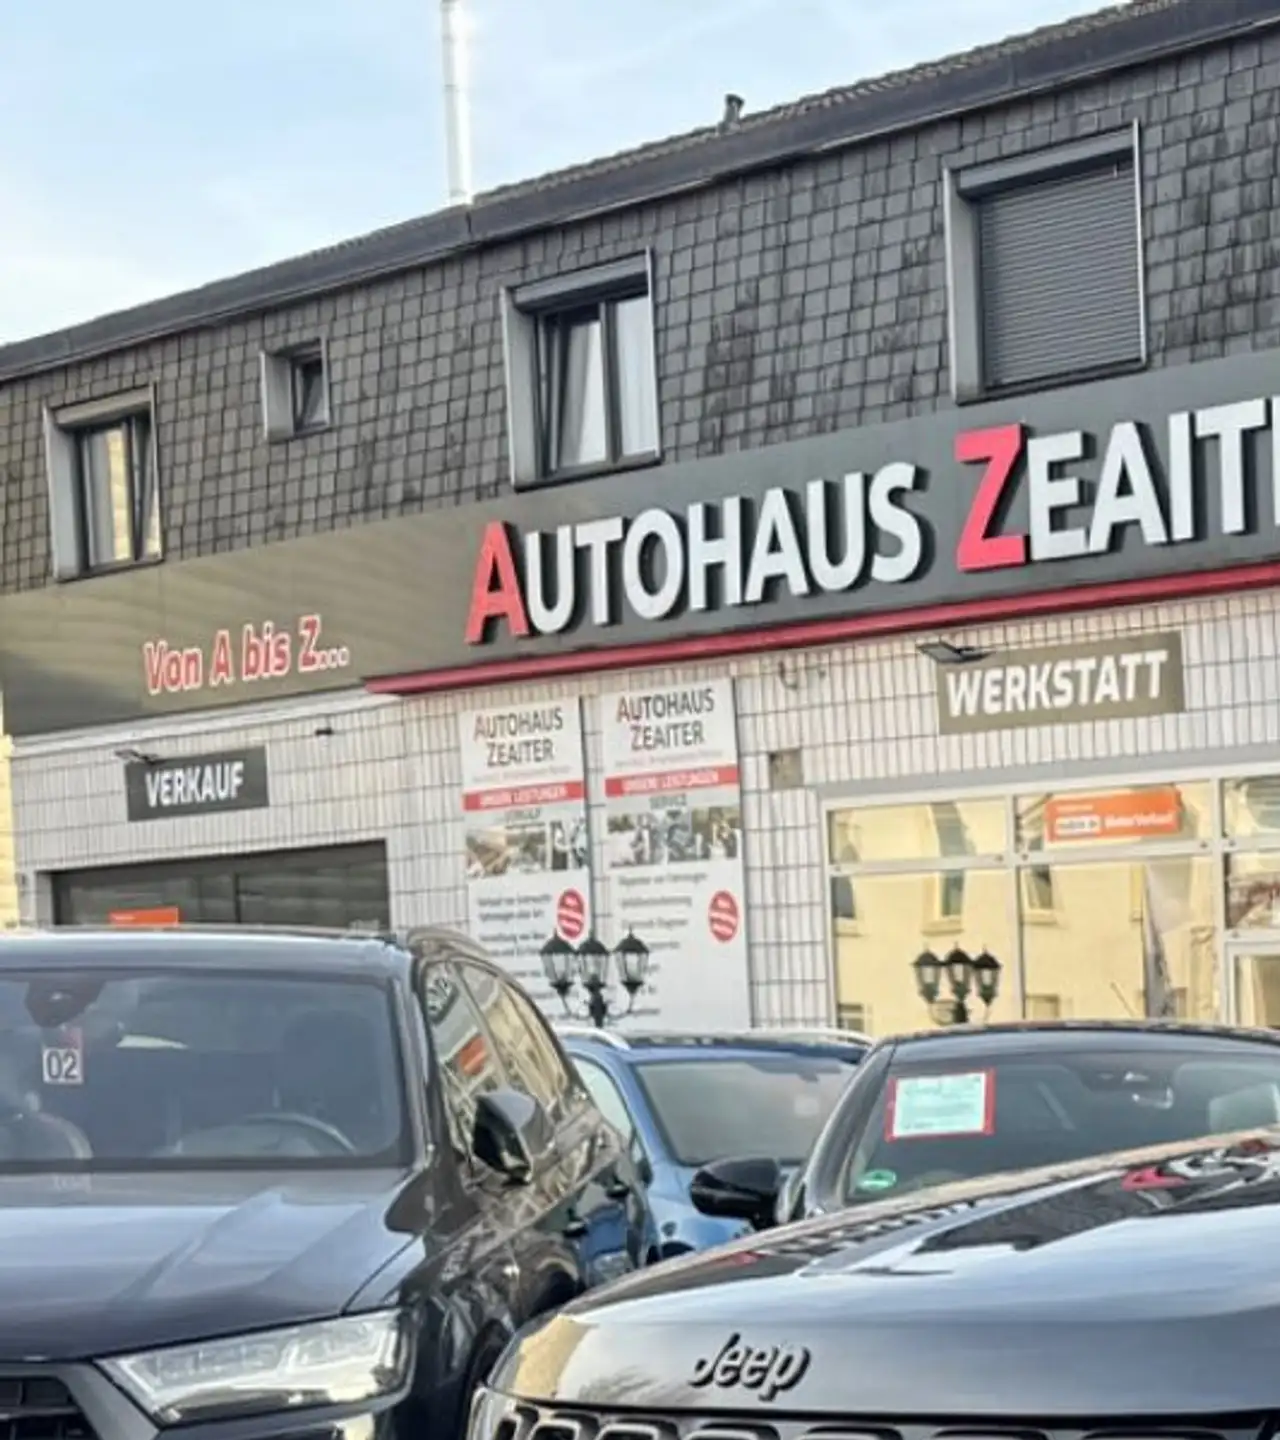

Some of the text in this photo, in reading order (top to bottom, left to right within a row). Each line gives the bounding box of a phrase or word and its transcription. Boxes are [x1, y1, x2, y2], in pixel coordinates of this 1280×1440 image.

[465, 462, 922, 645] AUTOHAUS
[144, 640, 203, 694] Von
[209, 629, 235, 686] A
[242, 620, 291, 682] bis
[946, 649, 1167, 719] WERKSTATT
[474, 706, 563, 741] AUTOHAUS
[616, 688, 715, 723] AUTOHAUS
[486, 738, 554, 767] ZEAITER
[630, 720, 705, 751] ZEAITER
[145, 760, 245, 807] VERKAUF
[46, 1049, 79, 1080] 02
[688, 1331, 811, 1402] Jeep
